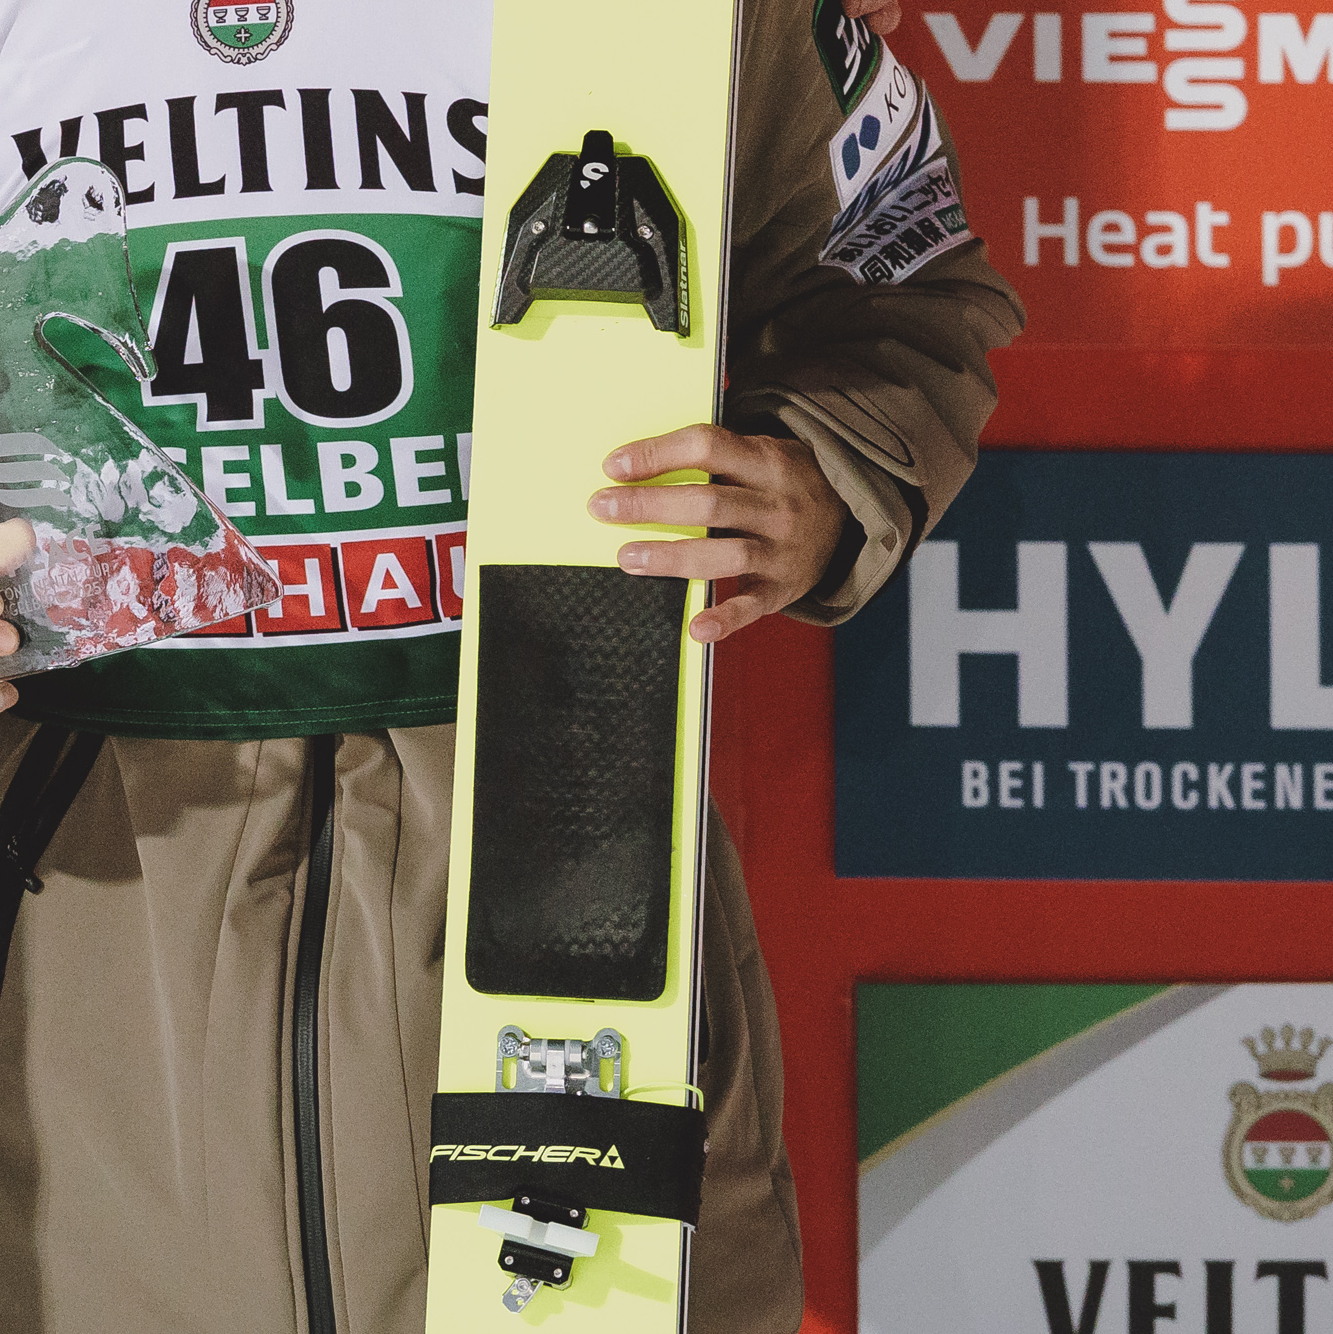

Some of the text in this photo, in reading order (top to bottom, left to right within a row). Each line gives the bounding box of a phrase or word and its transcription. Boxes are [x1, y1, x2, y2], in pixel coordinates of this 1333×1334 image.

[1022, 196, 1231, 268] Heat
[141, 227, 416, 432] 46
[171, 431, 473, 518] ELBE
[961, 761, 1047, 810] BEI
[430, 1143, 600, 1167] FISCHER
